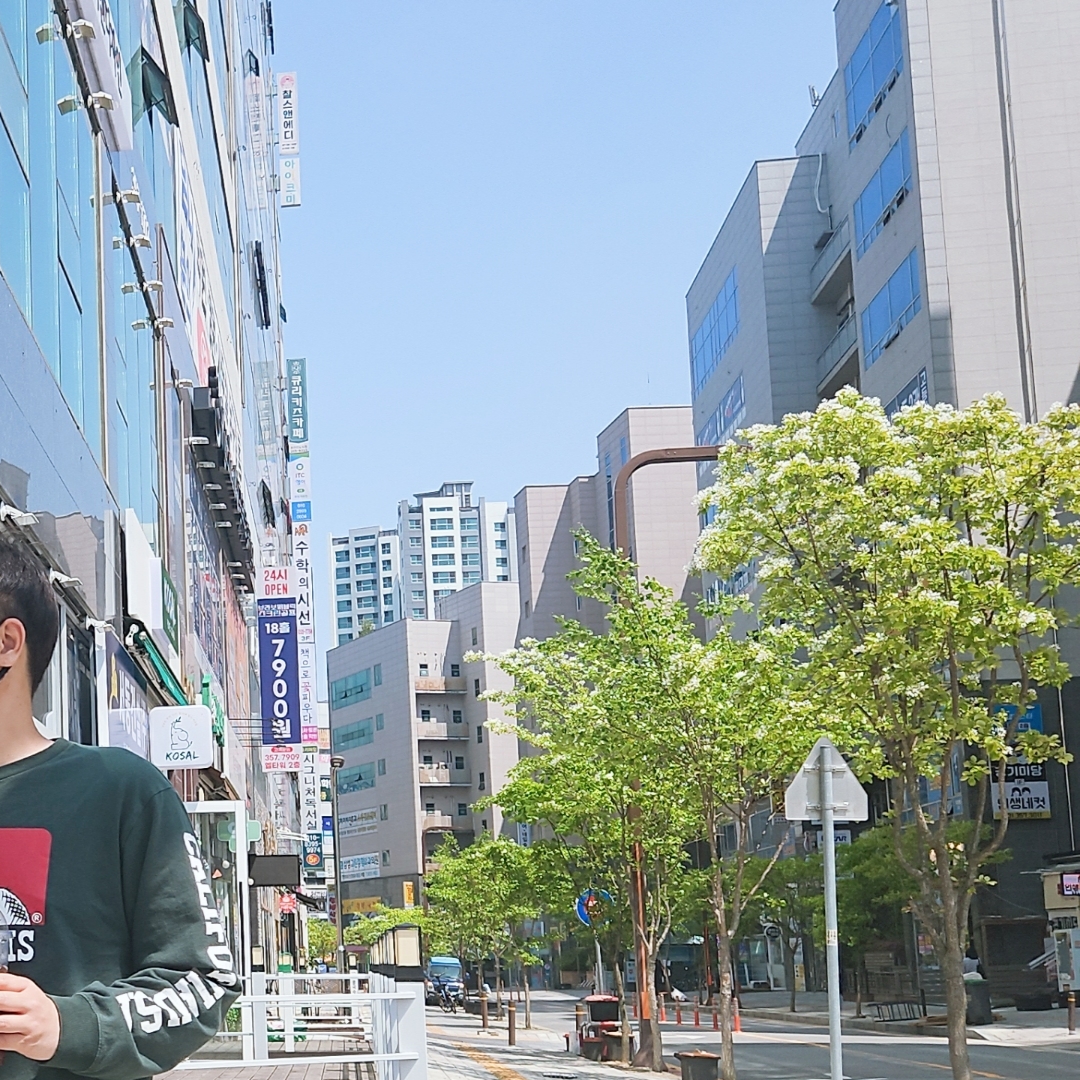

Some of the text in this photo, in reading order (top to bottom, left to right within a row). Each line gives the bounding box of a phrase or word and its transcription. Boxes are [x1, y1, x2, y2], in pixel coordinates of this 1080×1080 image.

[264, 569, 287, 581] 24시
[265, 583, 288, 596] OPEN
[265, 622, 290, 634] 18홀
[165, 751, 200, 761] KOSAL
